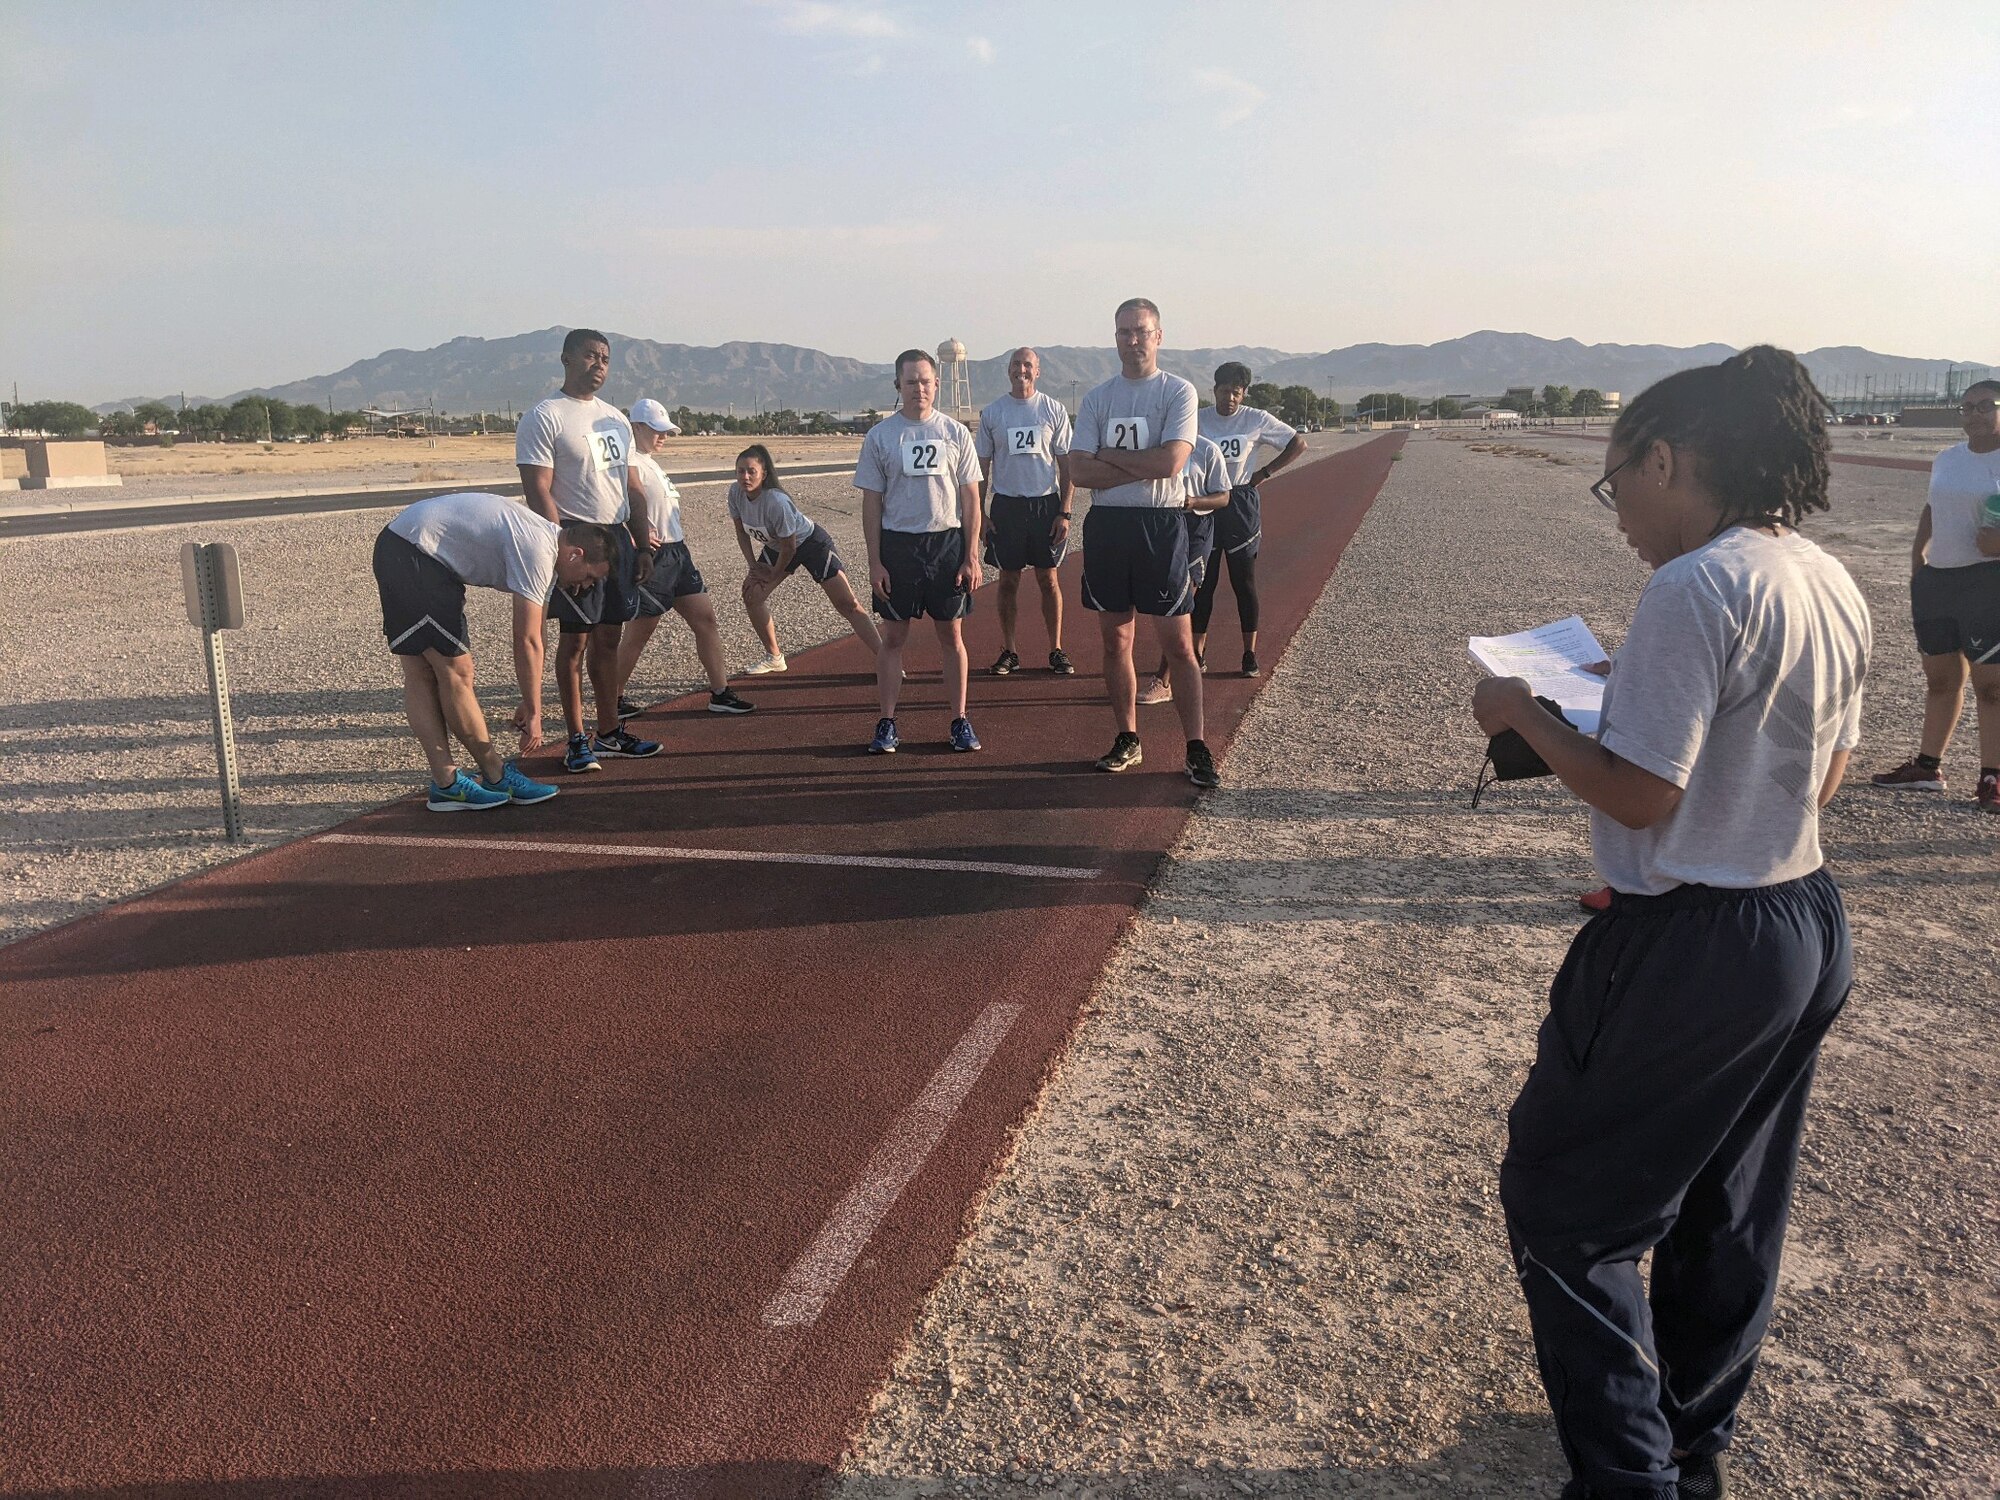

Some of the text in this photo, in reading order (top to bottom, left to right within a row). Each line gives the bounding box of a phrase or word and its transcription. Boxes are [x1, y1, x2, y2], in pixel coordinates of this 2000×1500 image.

[1016, 430, 1035, 449] 24
[1115, 423, 1139, 449] 21
[598, 436, 620, 462] 26
[912, 445, 938, 469] 22
[1221, 439, 1240, 458] 29
[749, 528, 768, 542] 28
